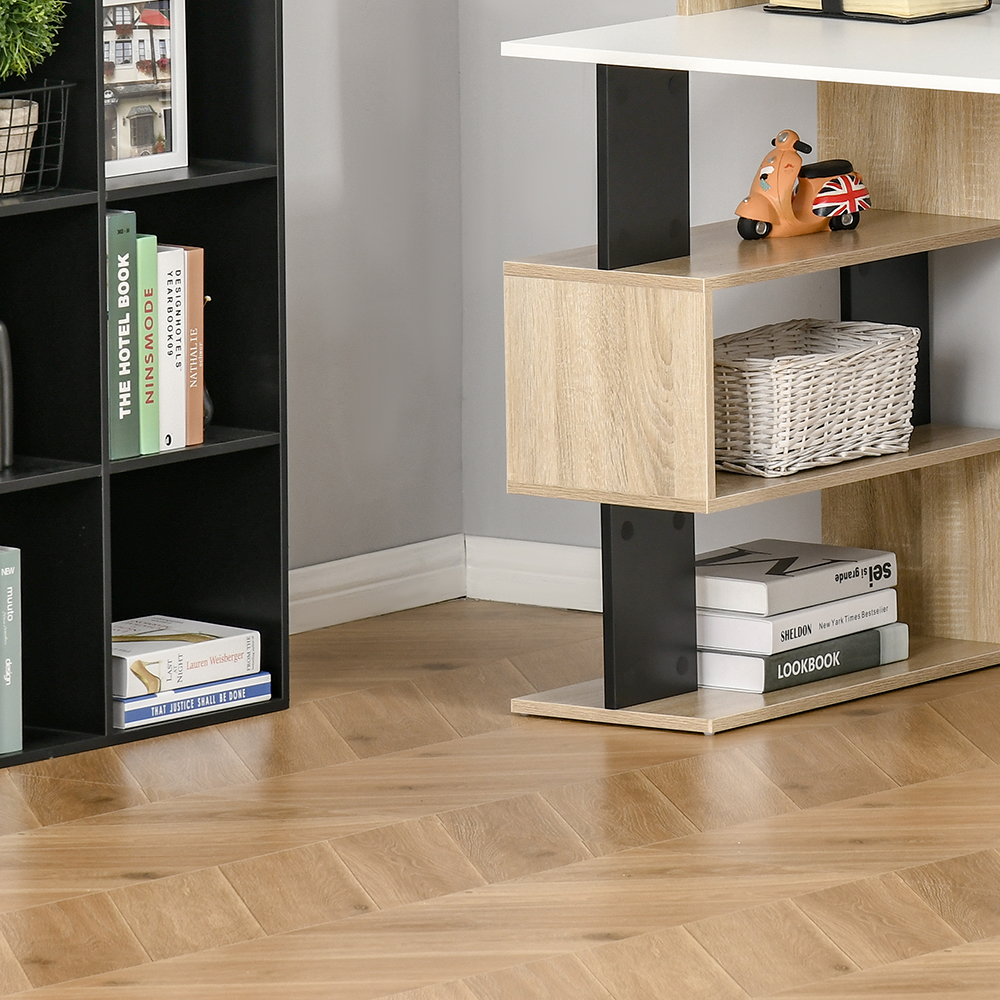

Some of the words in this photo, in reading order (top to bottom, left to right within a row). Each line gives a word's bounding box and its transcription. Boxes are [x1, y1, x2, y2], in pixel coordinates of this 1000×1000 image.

[117, 252, 130, 308] BOOK
[118, 312, 130, 375] HOTEL
[144, 287, 154, 405] NINSMODE
[189, 327, 198, 388] NATHALIE
[119, 380, 131, 420] THE
[834, 568, 860, 583] grande
[869, 562, 892, 588] sei
[780, 623, 812, 643] SHELDON
[818, 622, 831, 630] New
[844, 613, 861, 623] Times
[4, 658, 12, 686] design
[186, 659, 209, 671] Lauren
[209, 651, 245, 666] Weisberger
[777, 650, 841, 680] LOOKBOOK
[151, 705, 167, 716] THAT
[169, 699, 195, 713] JUSTICE
[197, 695, 216, 708] SHALL
[219, 693, 227, 703] BE
[229, 688, 246, 701] DONE
